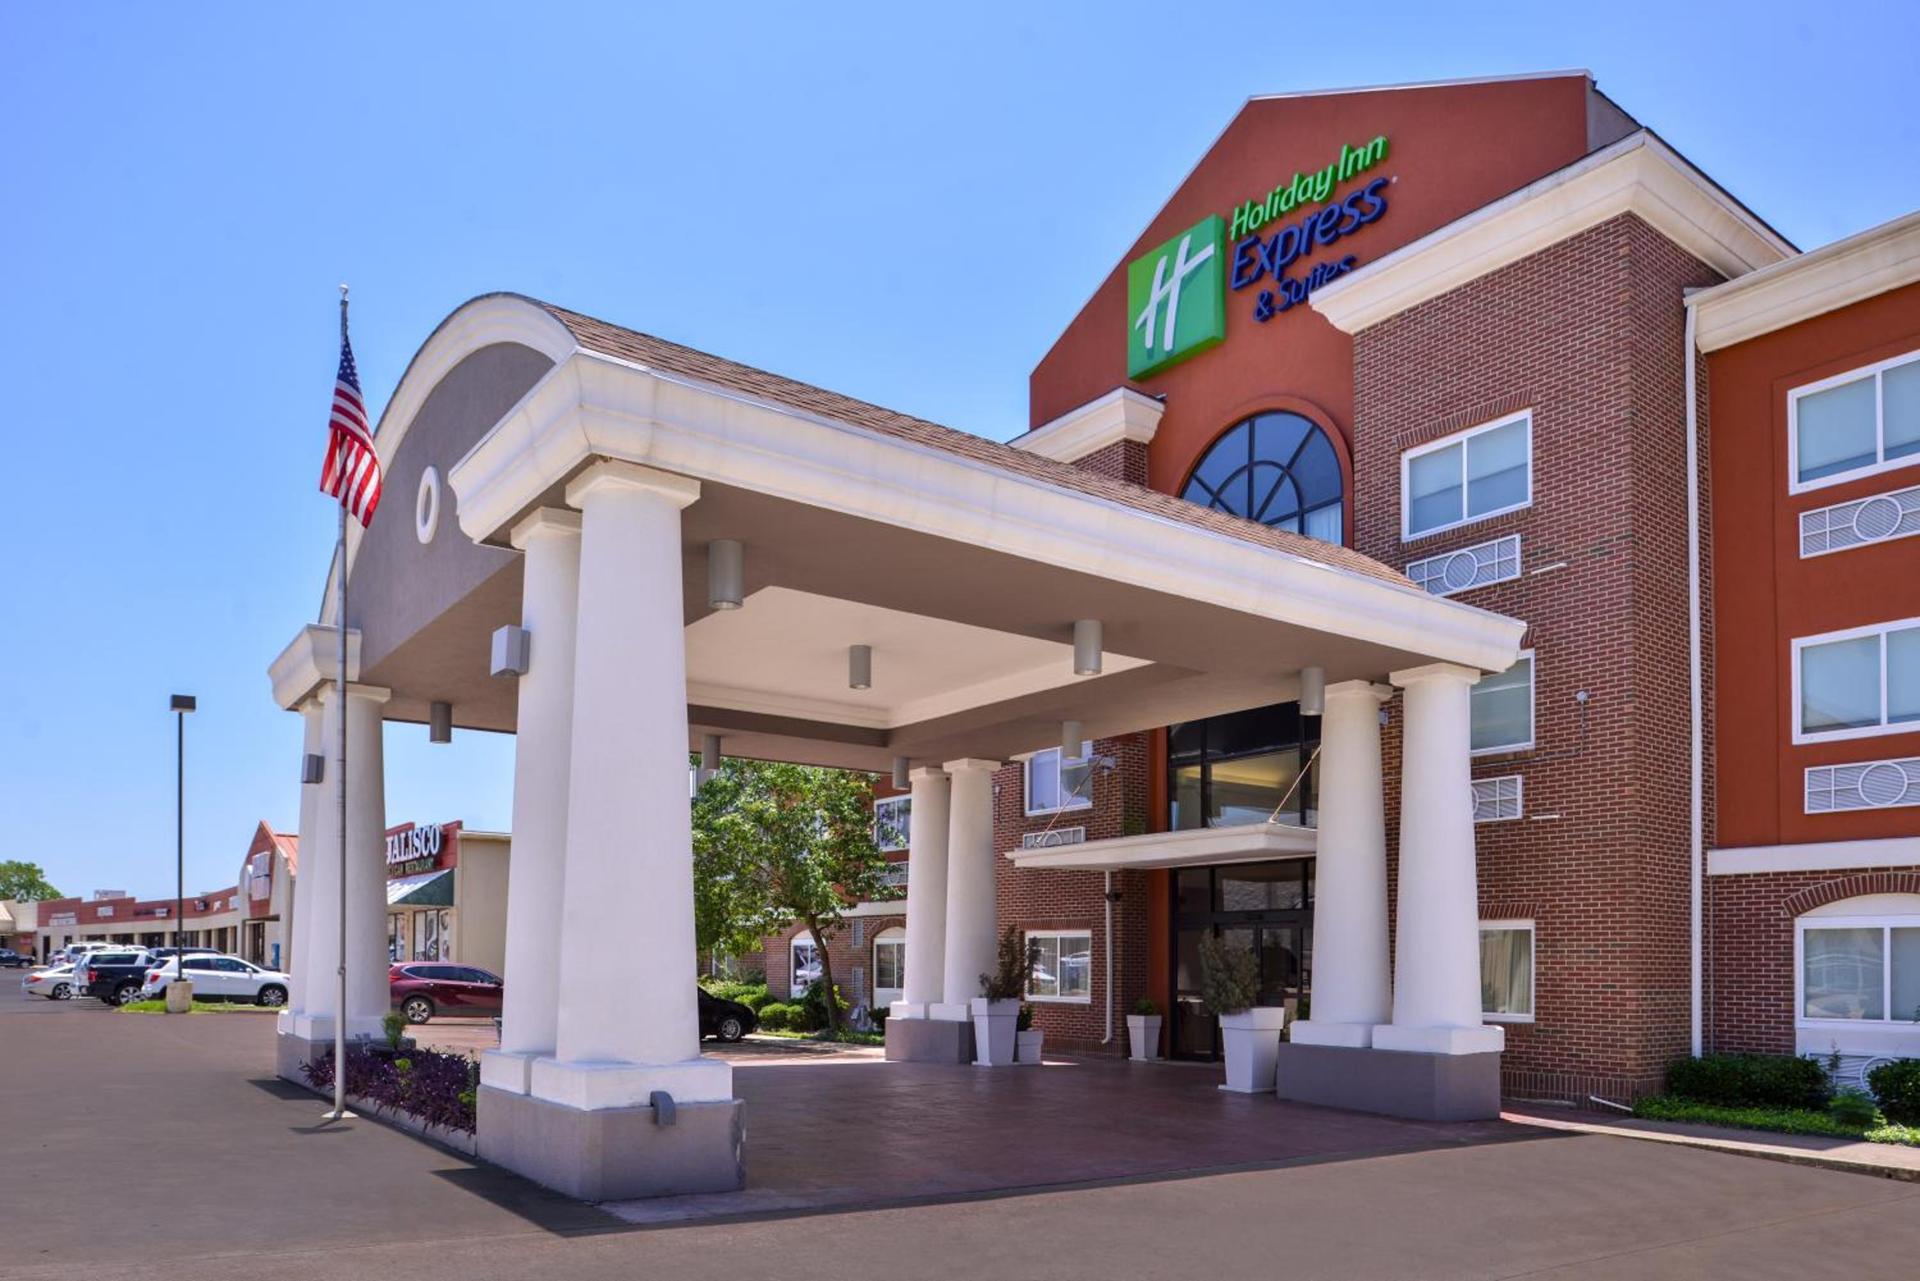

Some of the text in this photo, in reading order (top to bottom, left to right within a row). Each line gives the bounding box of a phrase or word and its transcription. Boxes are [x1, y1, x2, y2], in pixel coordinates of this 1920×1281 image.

[1229, 134, 1389, 242] Holiday Inn
[1231, 176, 1389, 290] Express
[1254, 288, 1275, 322] &
